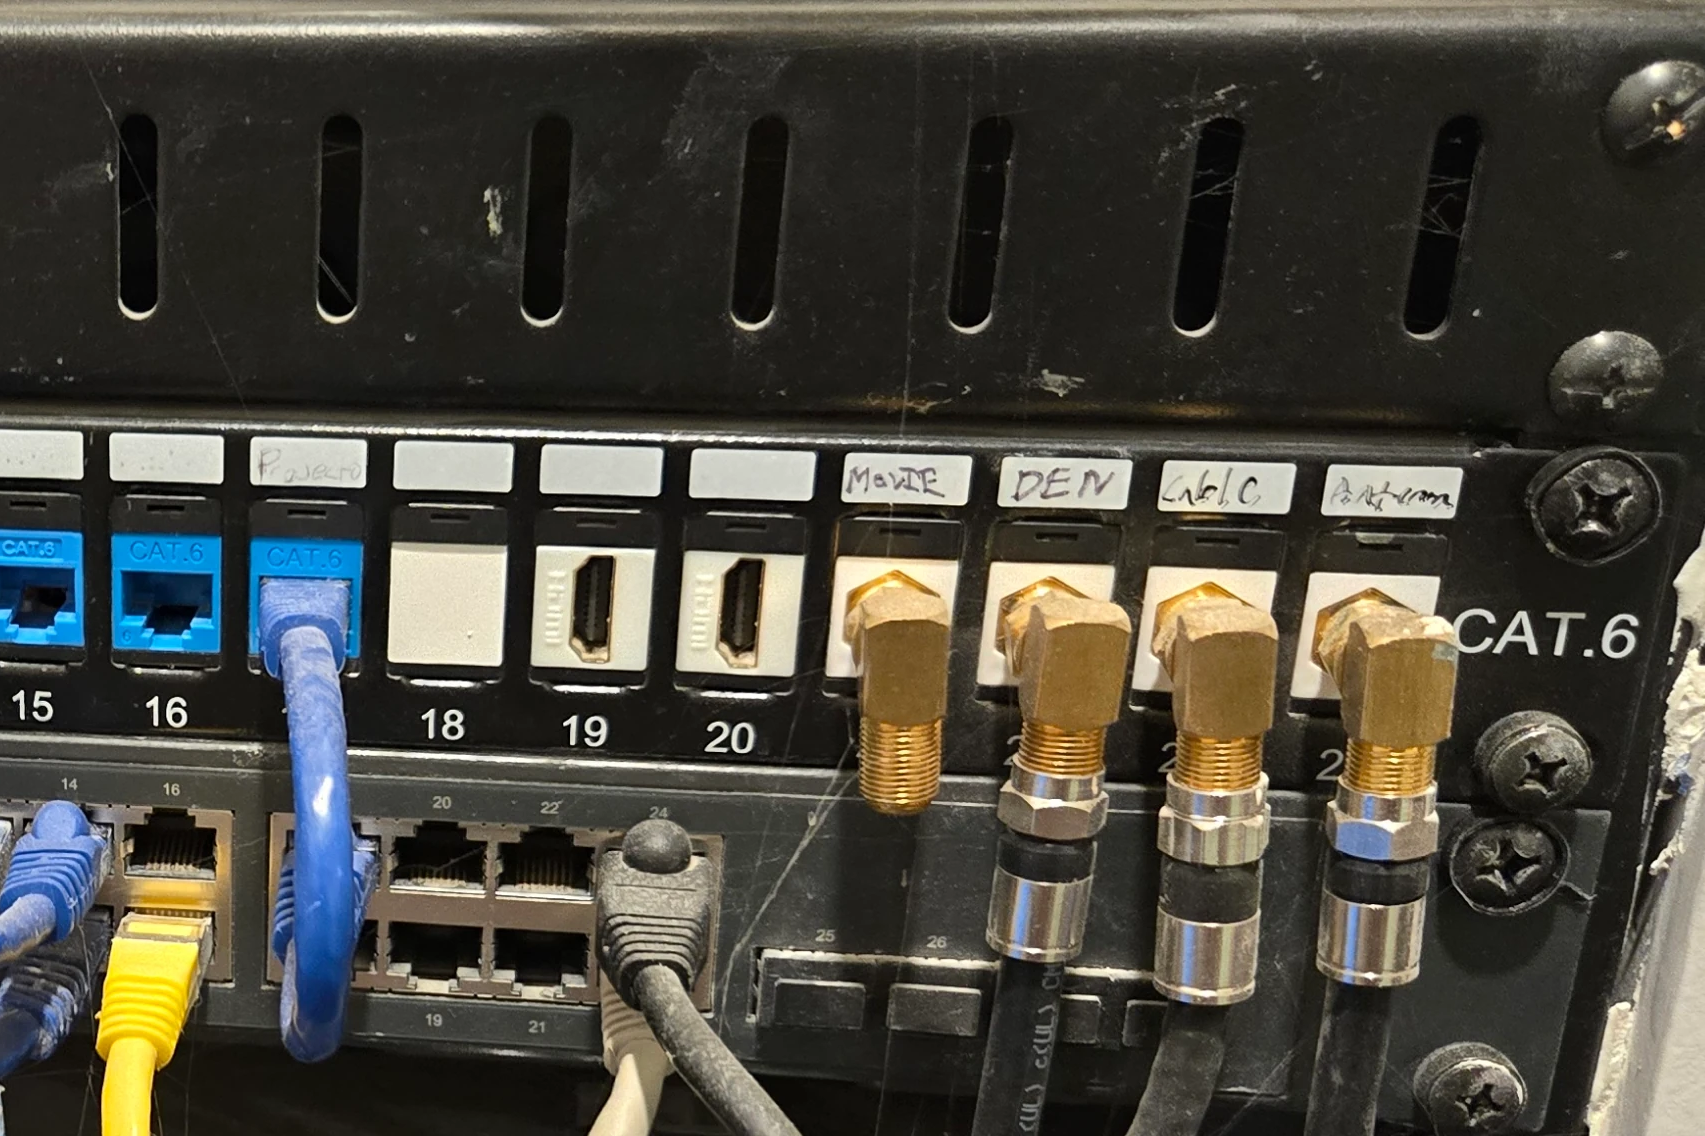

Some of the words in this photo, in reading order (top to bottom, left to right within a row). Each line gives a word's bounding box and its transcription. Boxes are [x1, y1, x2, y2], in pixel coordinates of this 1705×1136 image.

[1010, 467, 1116, 502] DEN
[1, 539, 56, 558] CAT.6
[129, 541, 204, 565] CAT.6
[266, 546, 343, 570] CAT.6
[1452, 607, 1640, 660] CAT.6
[11, 690, 54, 722] 15
[145, 696, 189, 728] 16
[420, 709, 466, 742] 18
[561, 715, 609, 748] 19
[704, 721, 756, 754] 20
[61, 778, 78, 791] 14
[162, 782, 181, 796] 16
[432, 796, 452, 811] 20
[540, 801, 561, 815] 22
[649, 806, 669, 820] 24
[815, 928, 836, 944] 25
[926, 935, 948, 950] 26
[425, 1013, 443, 1028] 19
[528, 1019, 547, 1034] 21
